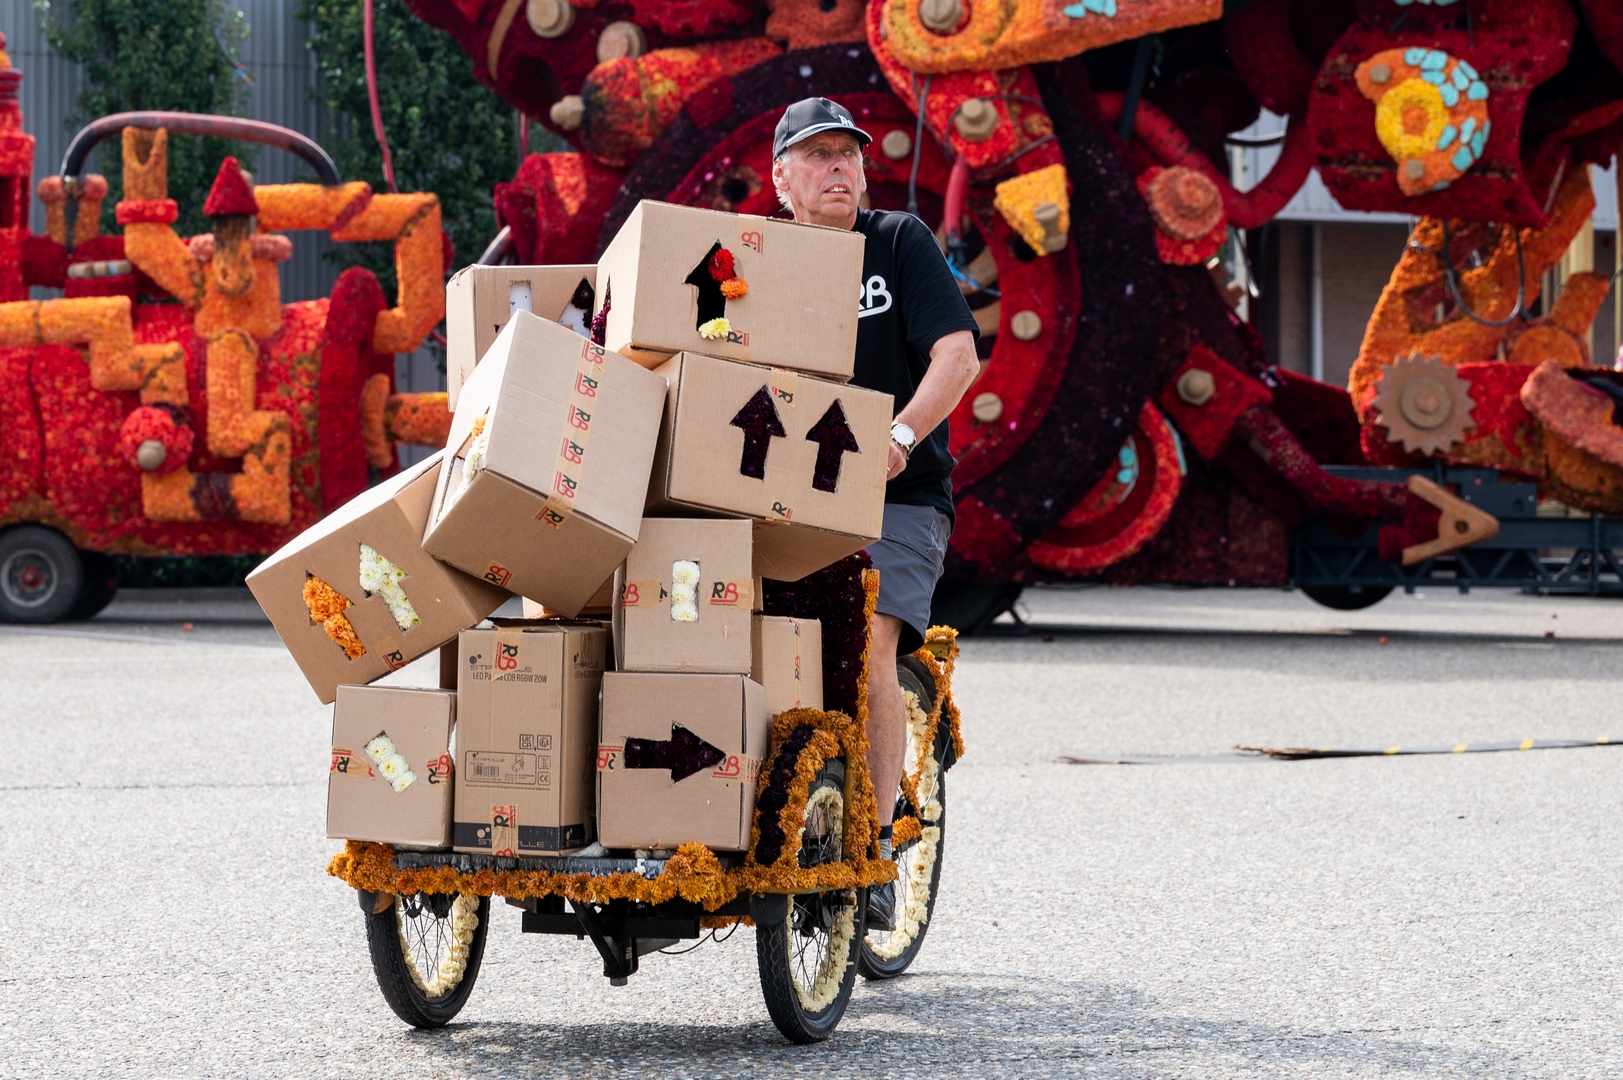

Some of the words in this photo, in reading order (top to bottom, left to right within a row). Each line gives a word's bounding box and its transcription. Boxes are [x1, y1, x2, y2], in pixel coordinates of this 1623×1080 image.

[727, 330, 747, 346] R
[577, 373, 598, 397] RB
[570, 406, 591, 430] RB
[563, 439, 584, 464] RB
[556, 472, 577, 498] RB
[711, 581, 739, 603] RB
[498, 642, 518, 671] RB
[473, 671, 484, 681] LED
[503, 673, 516, 682] COB
[534, 674, 548, 684] 20W
